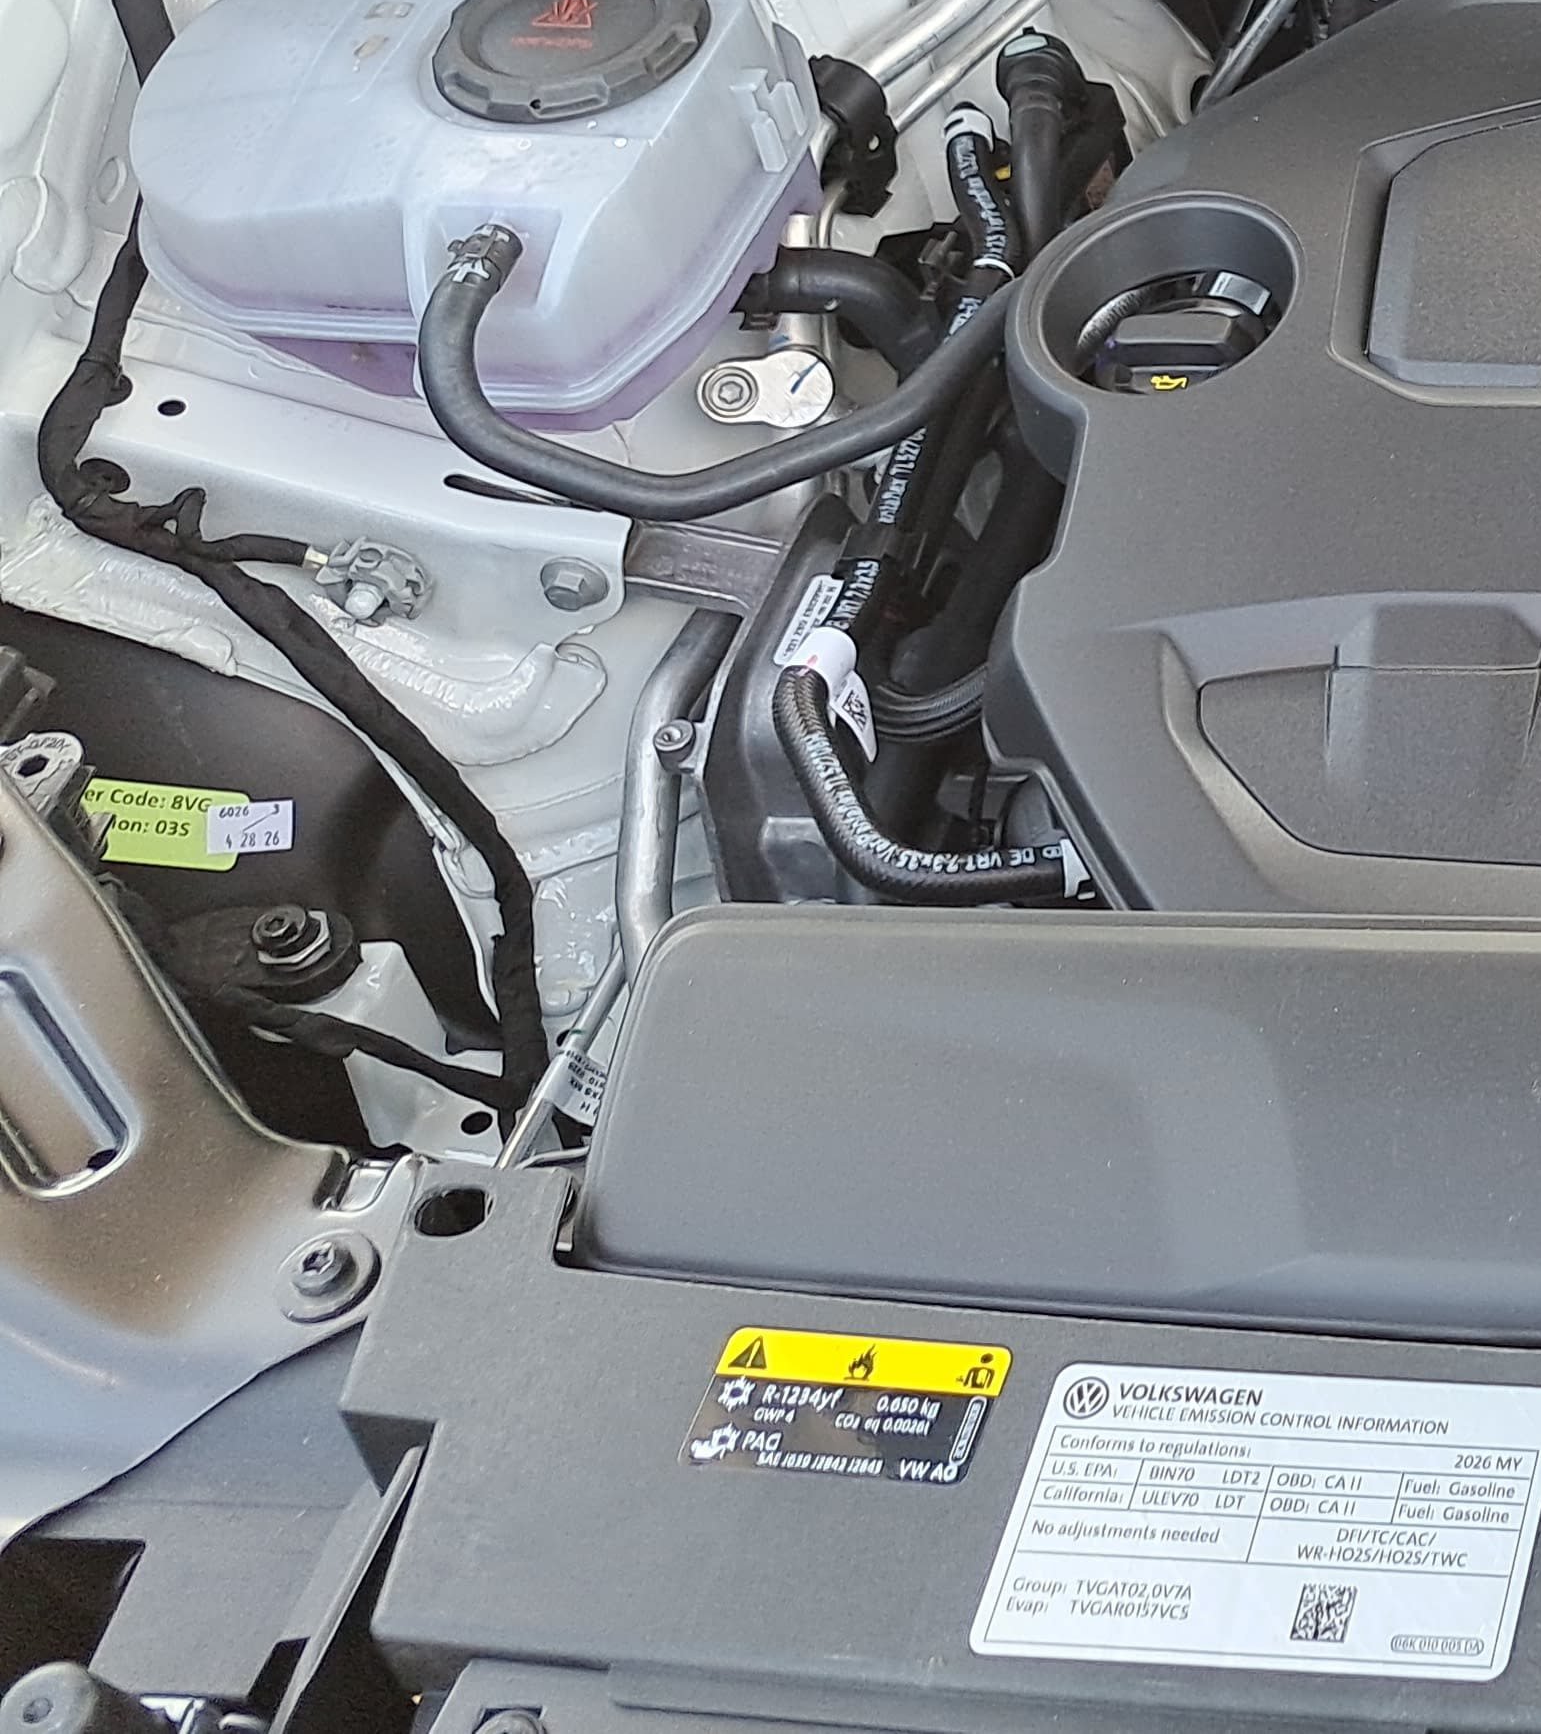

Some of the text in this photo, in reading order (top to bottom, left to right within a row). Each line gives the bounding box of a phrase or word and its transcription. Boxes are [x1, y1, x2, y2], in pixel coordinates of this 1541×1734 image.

[110, 789, 166, 808] Code:
[1120, 1382, 1263, 1407] VOLKSWAGEN
[1113, 1404, 1449, 1435] VEHICLE EMISSION CONTROL INFORMATION
[1061, 1434, 1252, 1458] Conforms to regulations:
[900, 1459, 931, 1480] VW
[1454, 1454, 1523, 1472] 2026 MY
[1051, 1460, 1516, 1499] U.S. BIN70 LDT2 CA II Fuel: Gasoline
[1043, 1485, 1509, 1524] California: ULEV70 LDT CA II Fuel: Gasoline
[1032, 1519, 1221, 1544] No adjustments needed
[1336, 1528, 1438, 1547] DFI/TC/CAC/
[1297, 1544, 1468, 1568] WR-HO2S/HO2S/TWC
[1013, 1577, 1067, 1596] Group:
